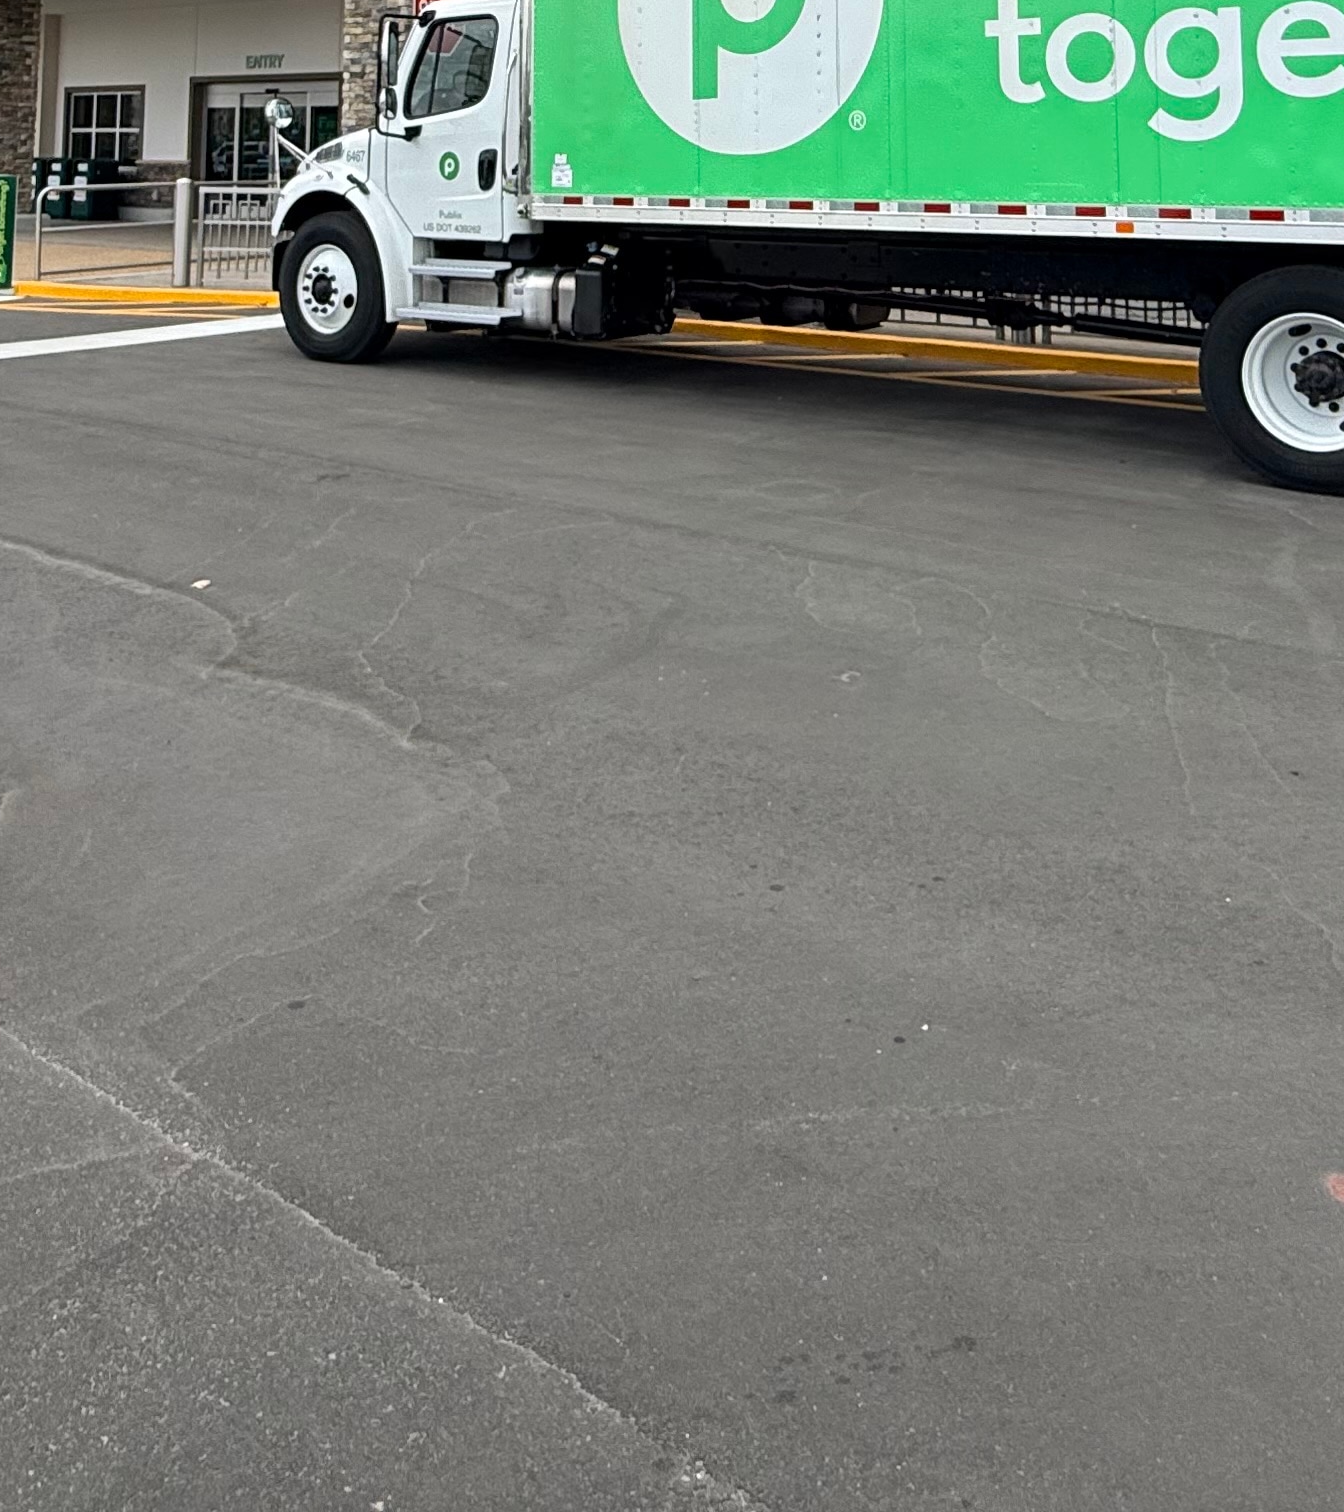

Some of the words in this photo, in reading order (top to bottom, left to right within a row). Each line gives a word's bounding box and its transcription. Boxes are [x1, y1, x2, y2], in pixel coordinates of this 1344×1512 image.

[245, 53, 285, 69] ENTRY
[423, 222, 434, 232] US
[436, 223, 452, 232] DOT
